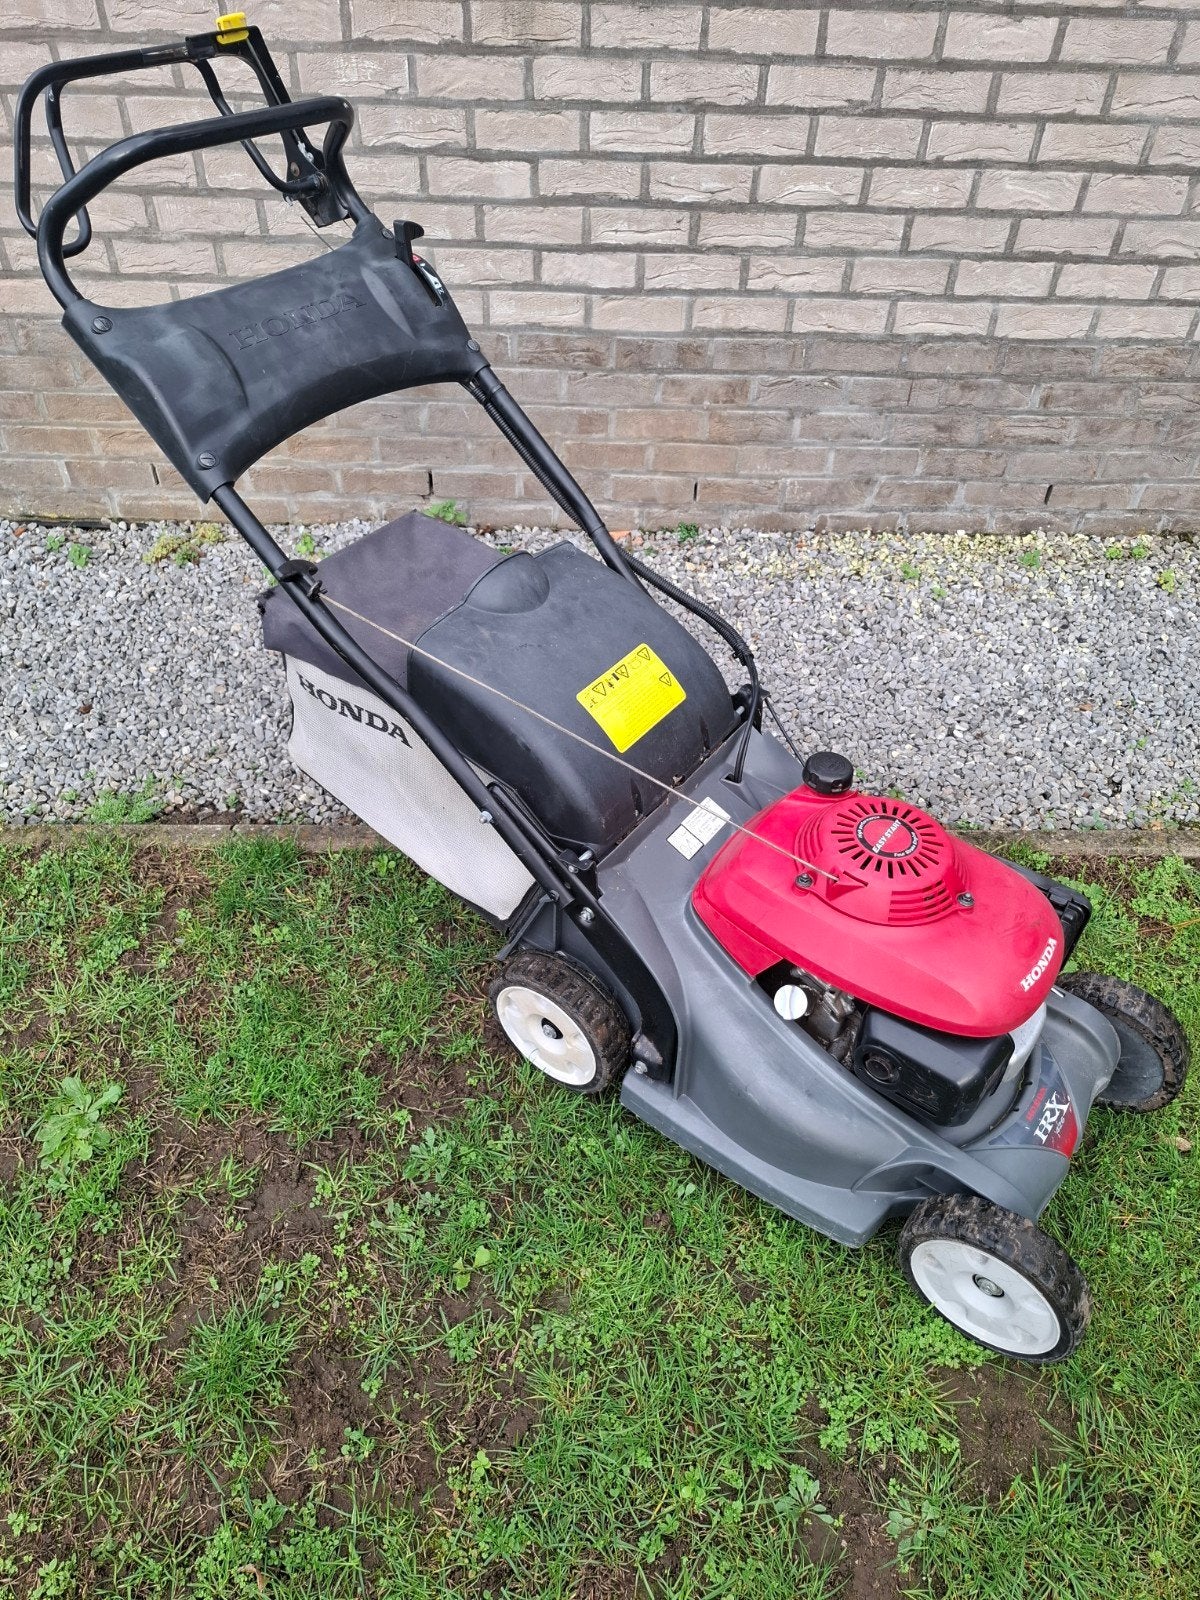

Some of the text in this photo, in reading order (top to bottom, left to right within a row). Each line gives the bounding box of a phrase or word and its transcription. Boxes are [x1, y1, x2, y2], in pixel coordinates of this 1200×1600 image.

[228, 293, 367, 350] HONDA
[296, 671, 413, 749] HONDA
[872, 819, 902, 854] EASY START
[1020, 937, 1057, 992] HONDA
[1033, 1091, 1071, 1145] HRX
